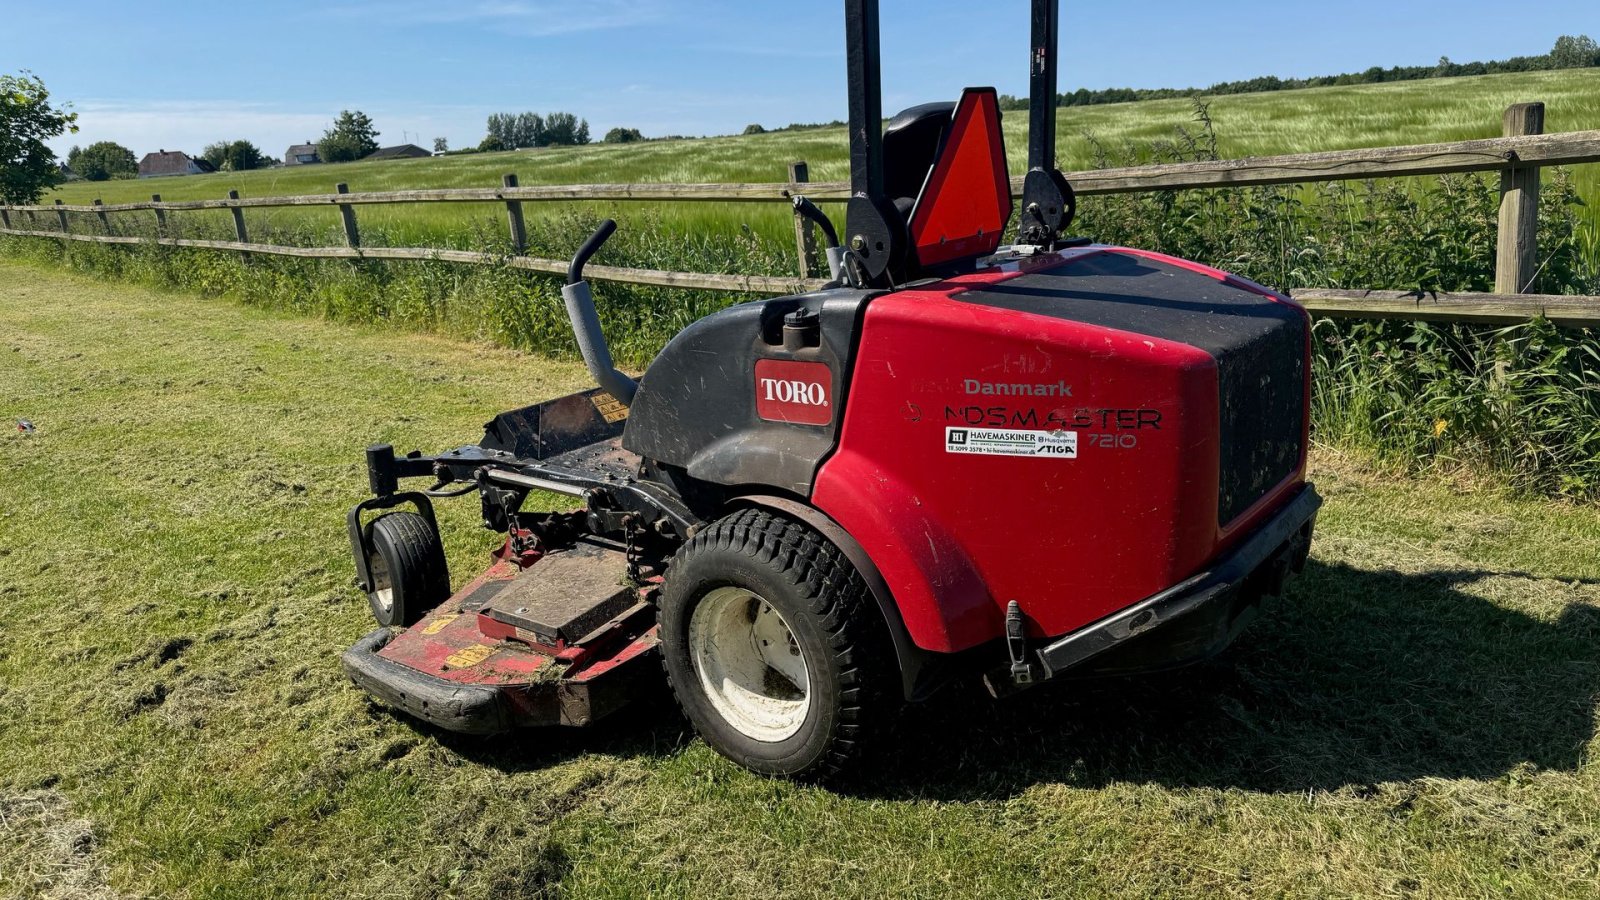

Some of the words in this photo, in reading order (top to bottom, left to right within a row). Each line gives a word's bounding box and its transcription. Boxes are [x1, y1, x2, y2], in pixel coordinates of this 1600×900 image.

[761, 378, 825, 406] TORO
[964, 379, 1073, 397] Danmark
[952, 432, 963, 442] HI
[970, 431, 1036, 442] HAVEMASKINER
[1088, 433, 1137, 449] 7210
[1037, 445, 1075, 454] STIGA
